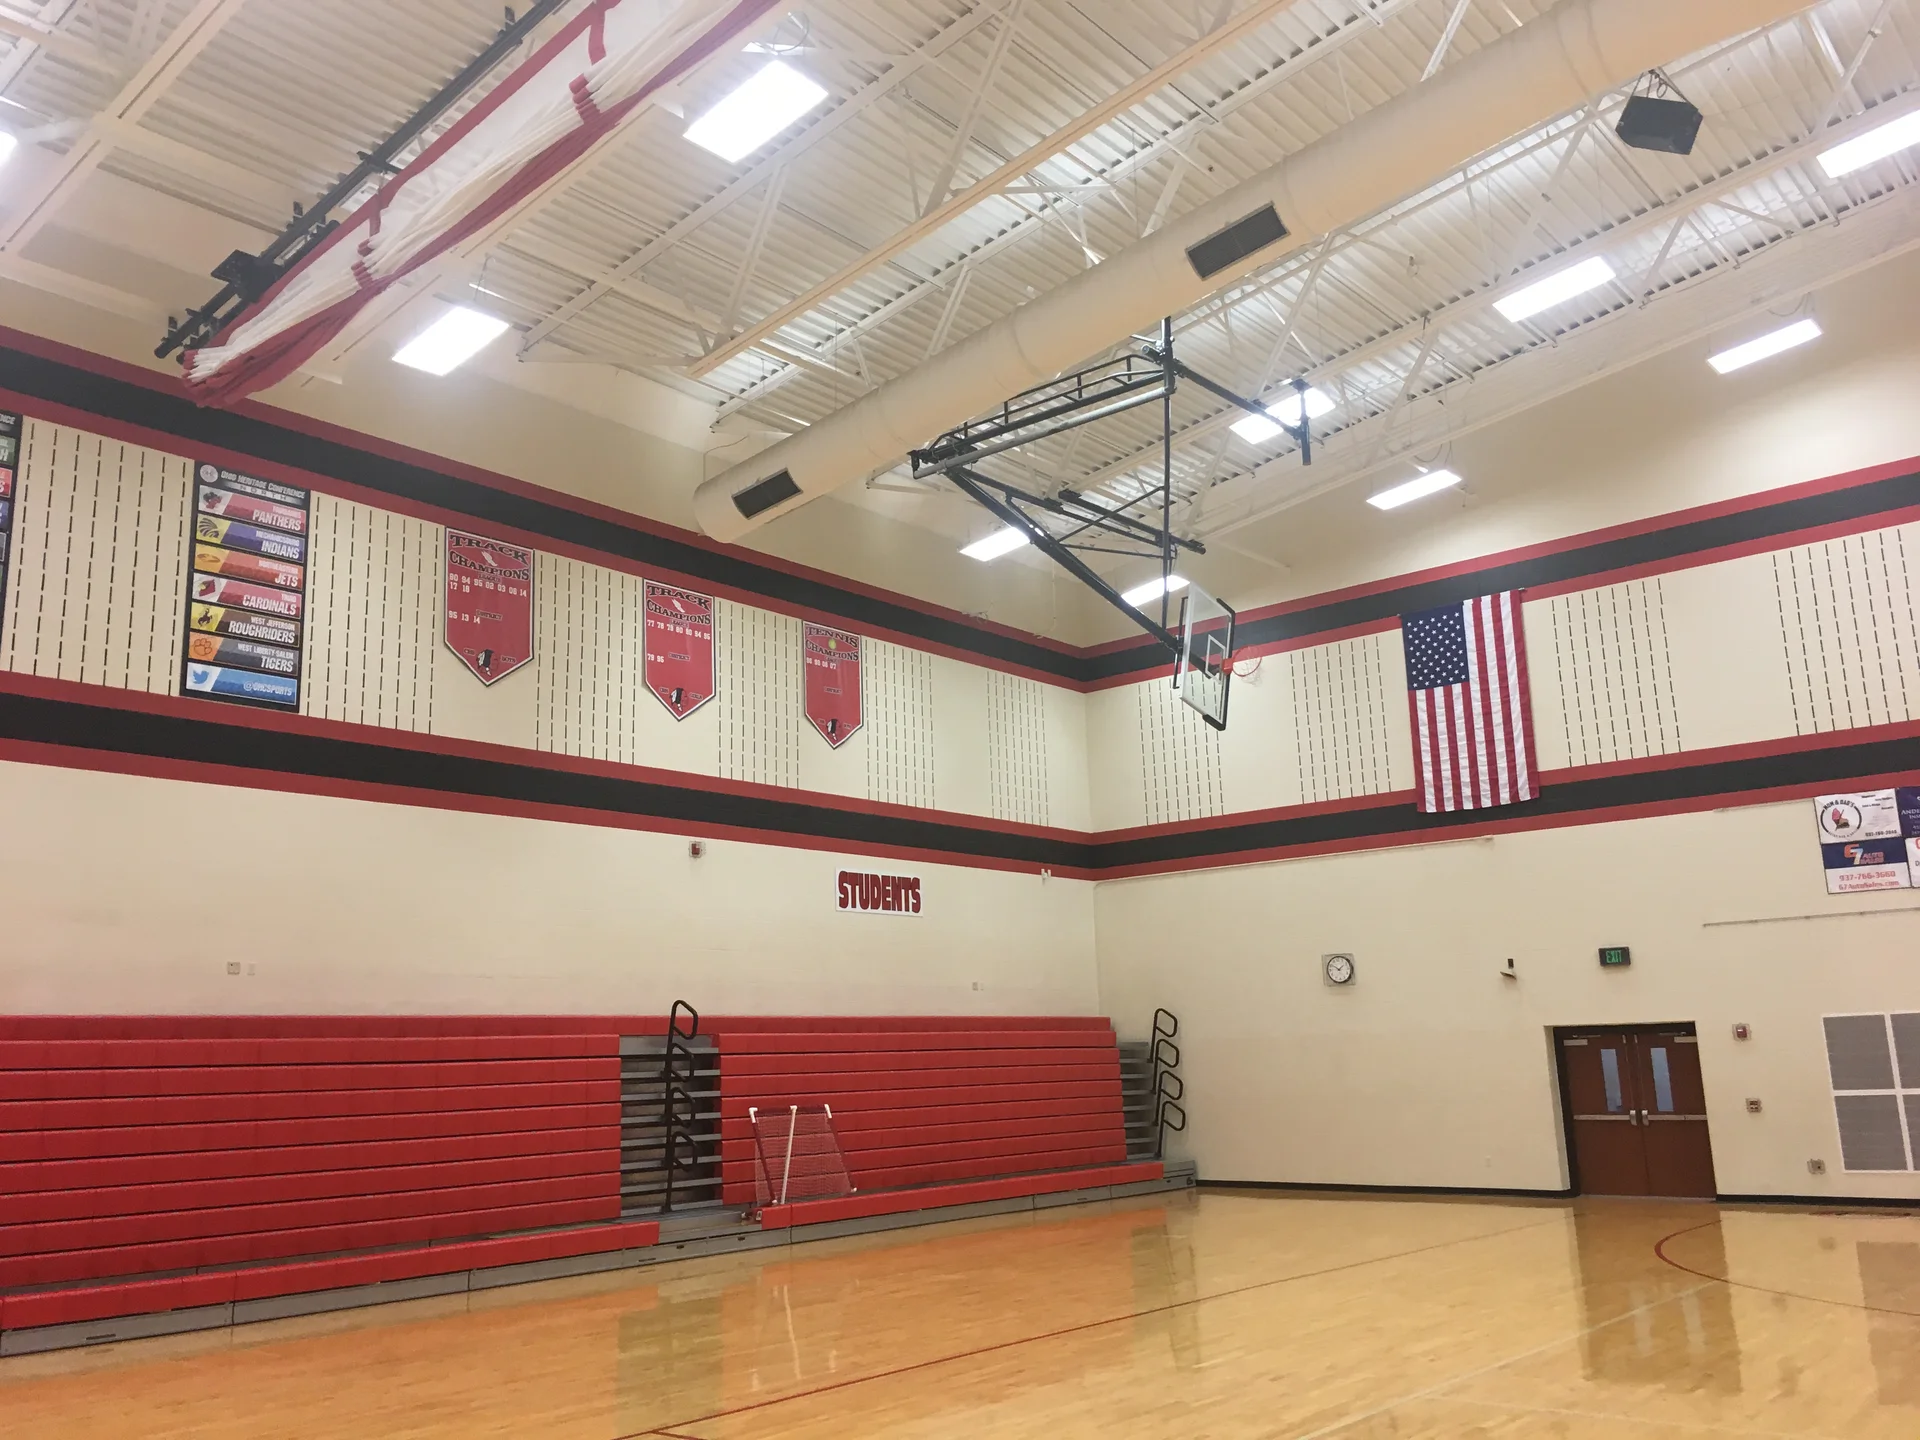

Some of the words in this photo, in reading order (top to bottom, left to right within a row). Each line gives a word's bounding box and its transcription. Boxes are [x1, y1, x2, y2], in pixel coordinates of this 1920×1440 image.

[268, 483, 306, 500] CONFERENCE
[252, 508, 301, 532] PANTHERS
[261, 540, 300, 559] INDIANS
[450, 534, 530, 568] TRACK
[449, 550, 530, 581] CHAMPIONS
[274, 572, 299, 588] JETS
[242, 594, 297, 616] CARDINALS
[647, 585, 711, 612] TRACK
[250, 616, 265, 626] WEST
[266, 619, 296, 632] JEFFERSON
[646, 599, 711, 626] CHAMPIONS
[228, 620, 296, 645] ROUGHRIDERS
[806, 625, 859, 649] TENNIS
[237, 643, 253, 653] WEST
[805, 639, 860, 663] CHAMPIONS
[261, 655, 295, 673] TIGERS
[1823, 801, 1835, 811] MOM
[837, 870, 921, 914] STUDENTS
[1606, 950, 1622, 963] EXIT
